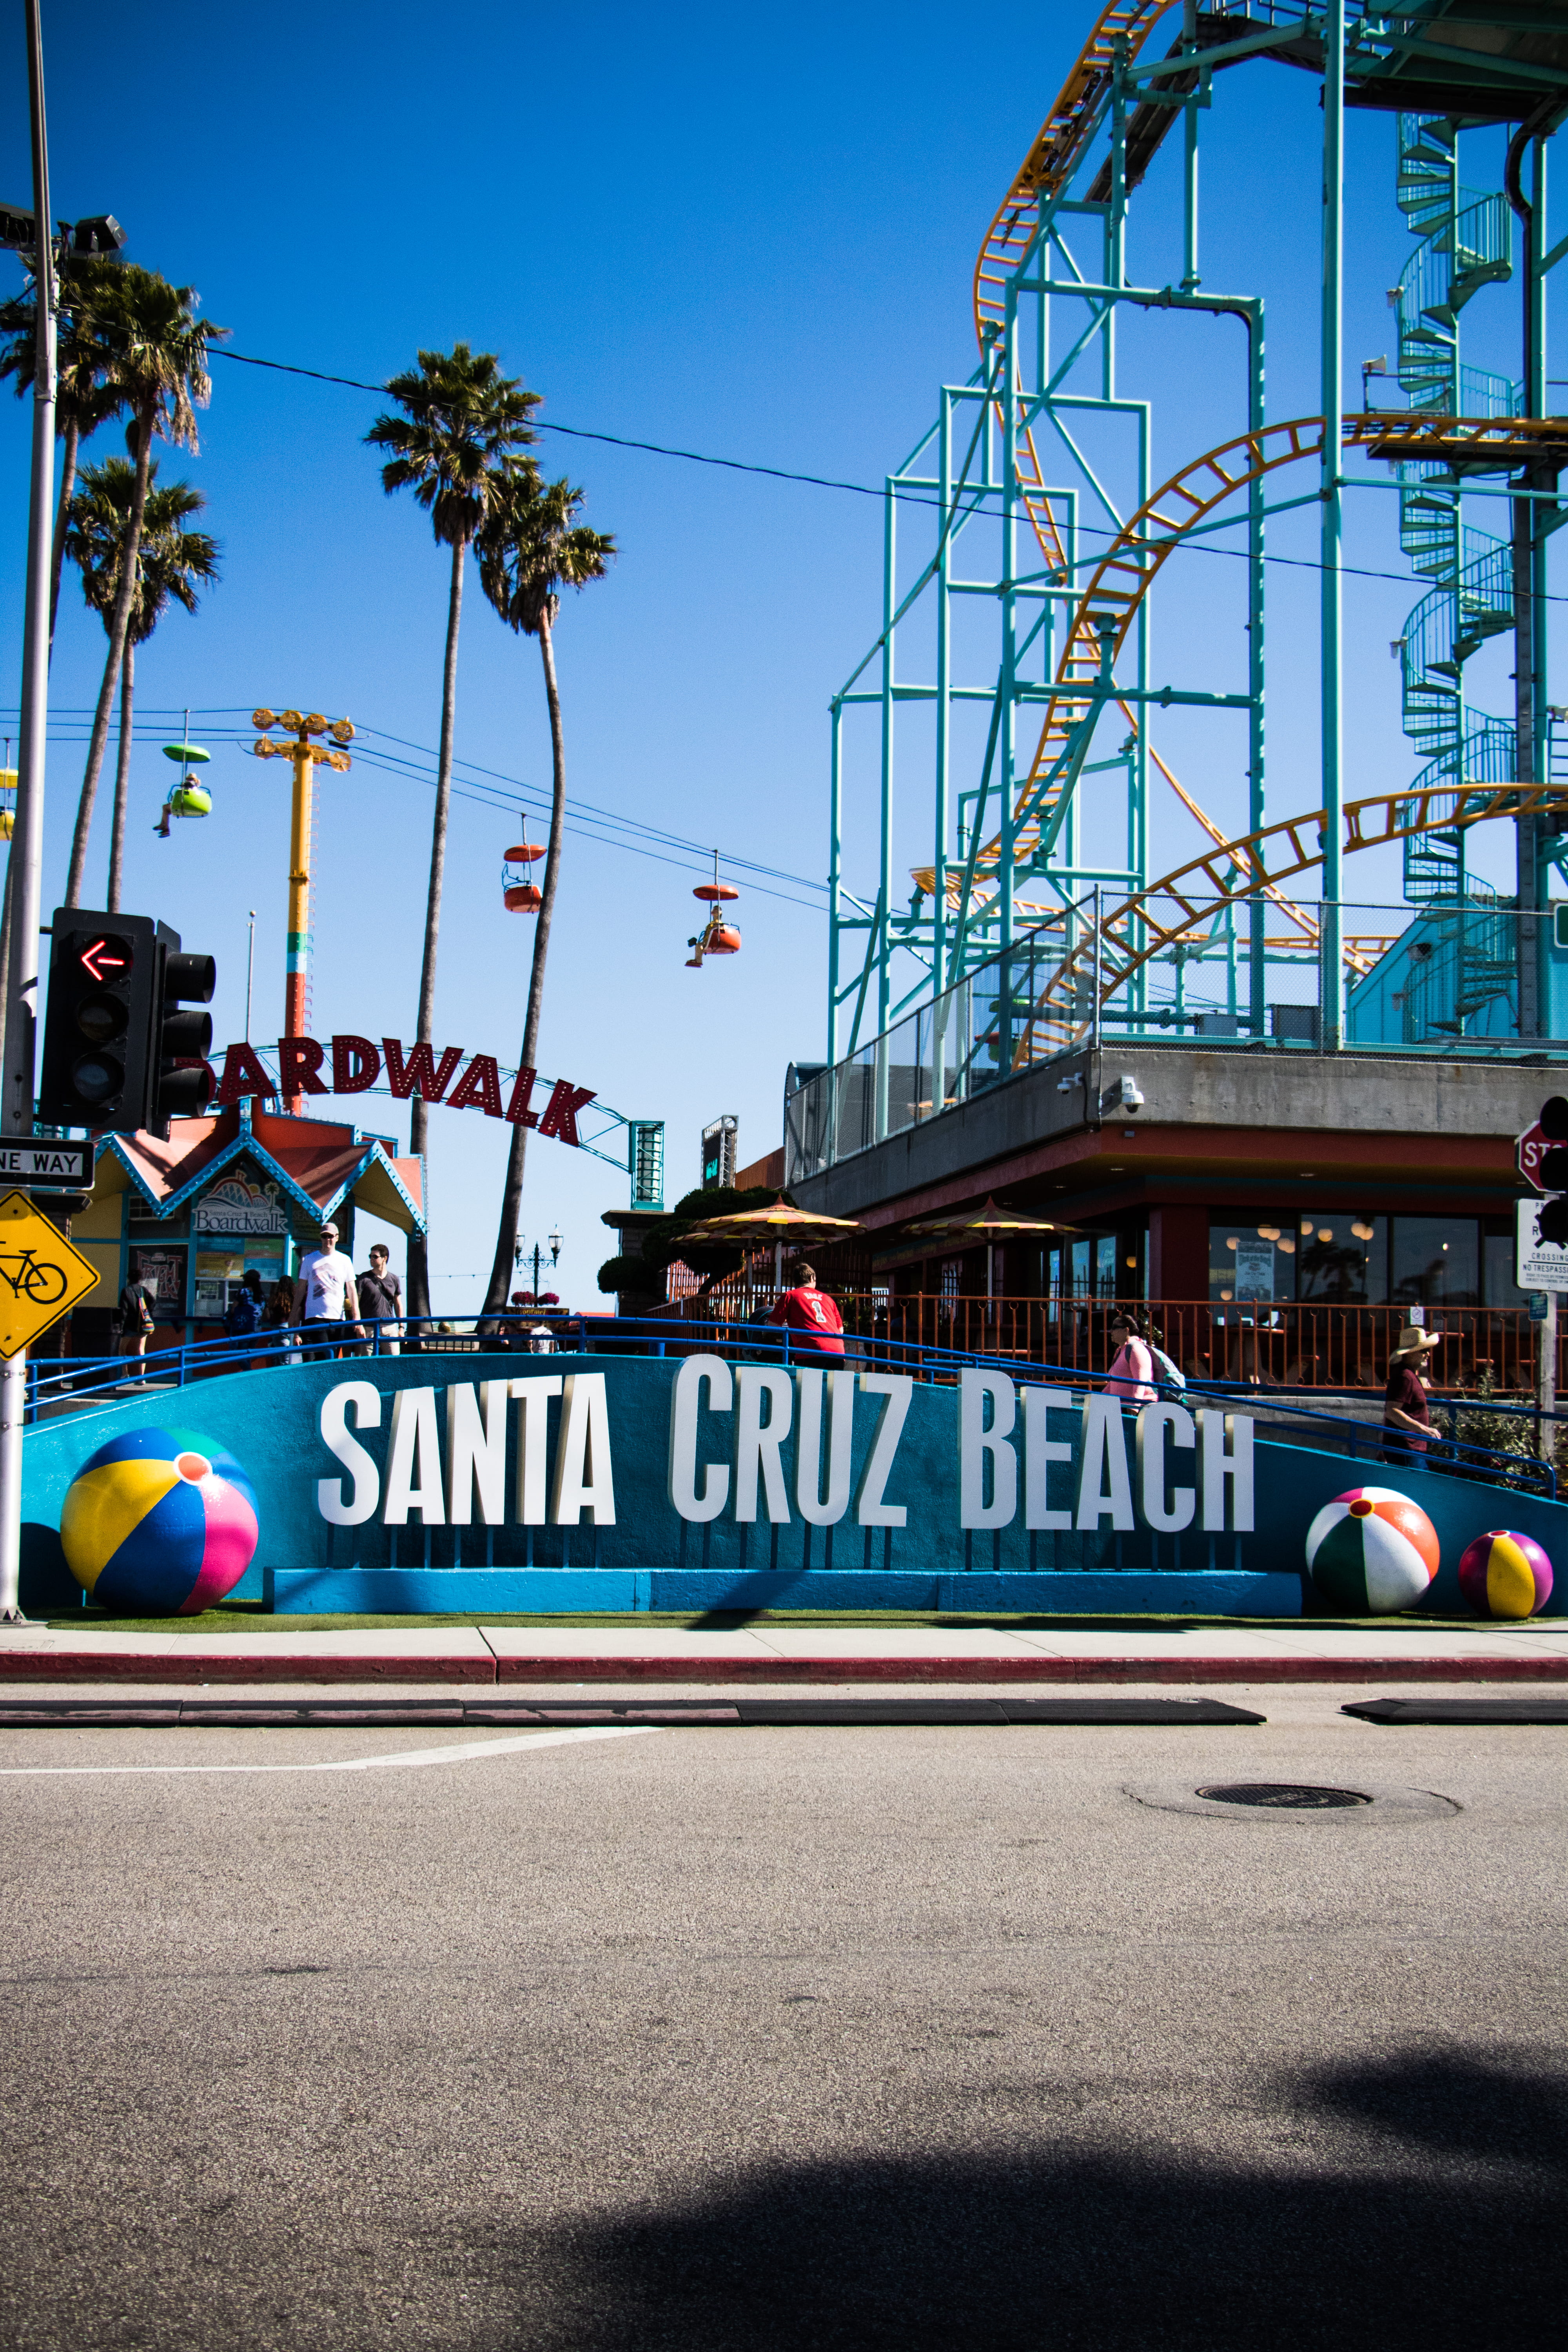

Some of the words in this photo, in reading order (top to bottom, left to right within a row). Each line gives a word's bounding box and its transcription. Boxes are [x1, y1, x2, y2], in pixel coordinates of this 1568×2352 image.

[33, 1153, 78, 1173] WAY
[195, 1210, 289, 1232] Boardwalk
[811, 1301, 827, 1323] 1
[316, 1372, 616, 1526] SANTA
[668, 1354, 913, 1527] CRUZ
[957, 1367, 1254, 1532] BEACH
